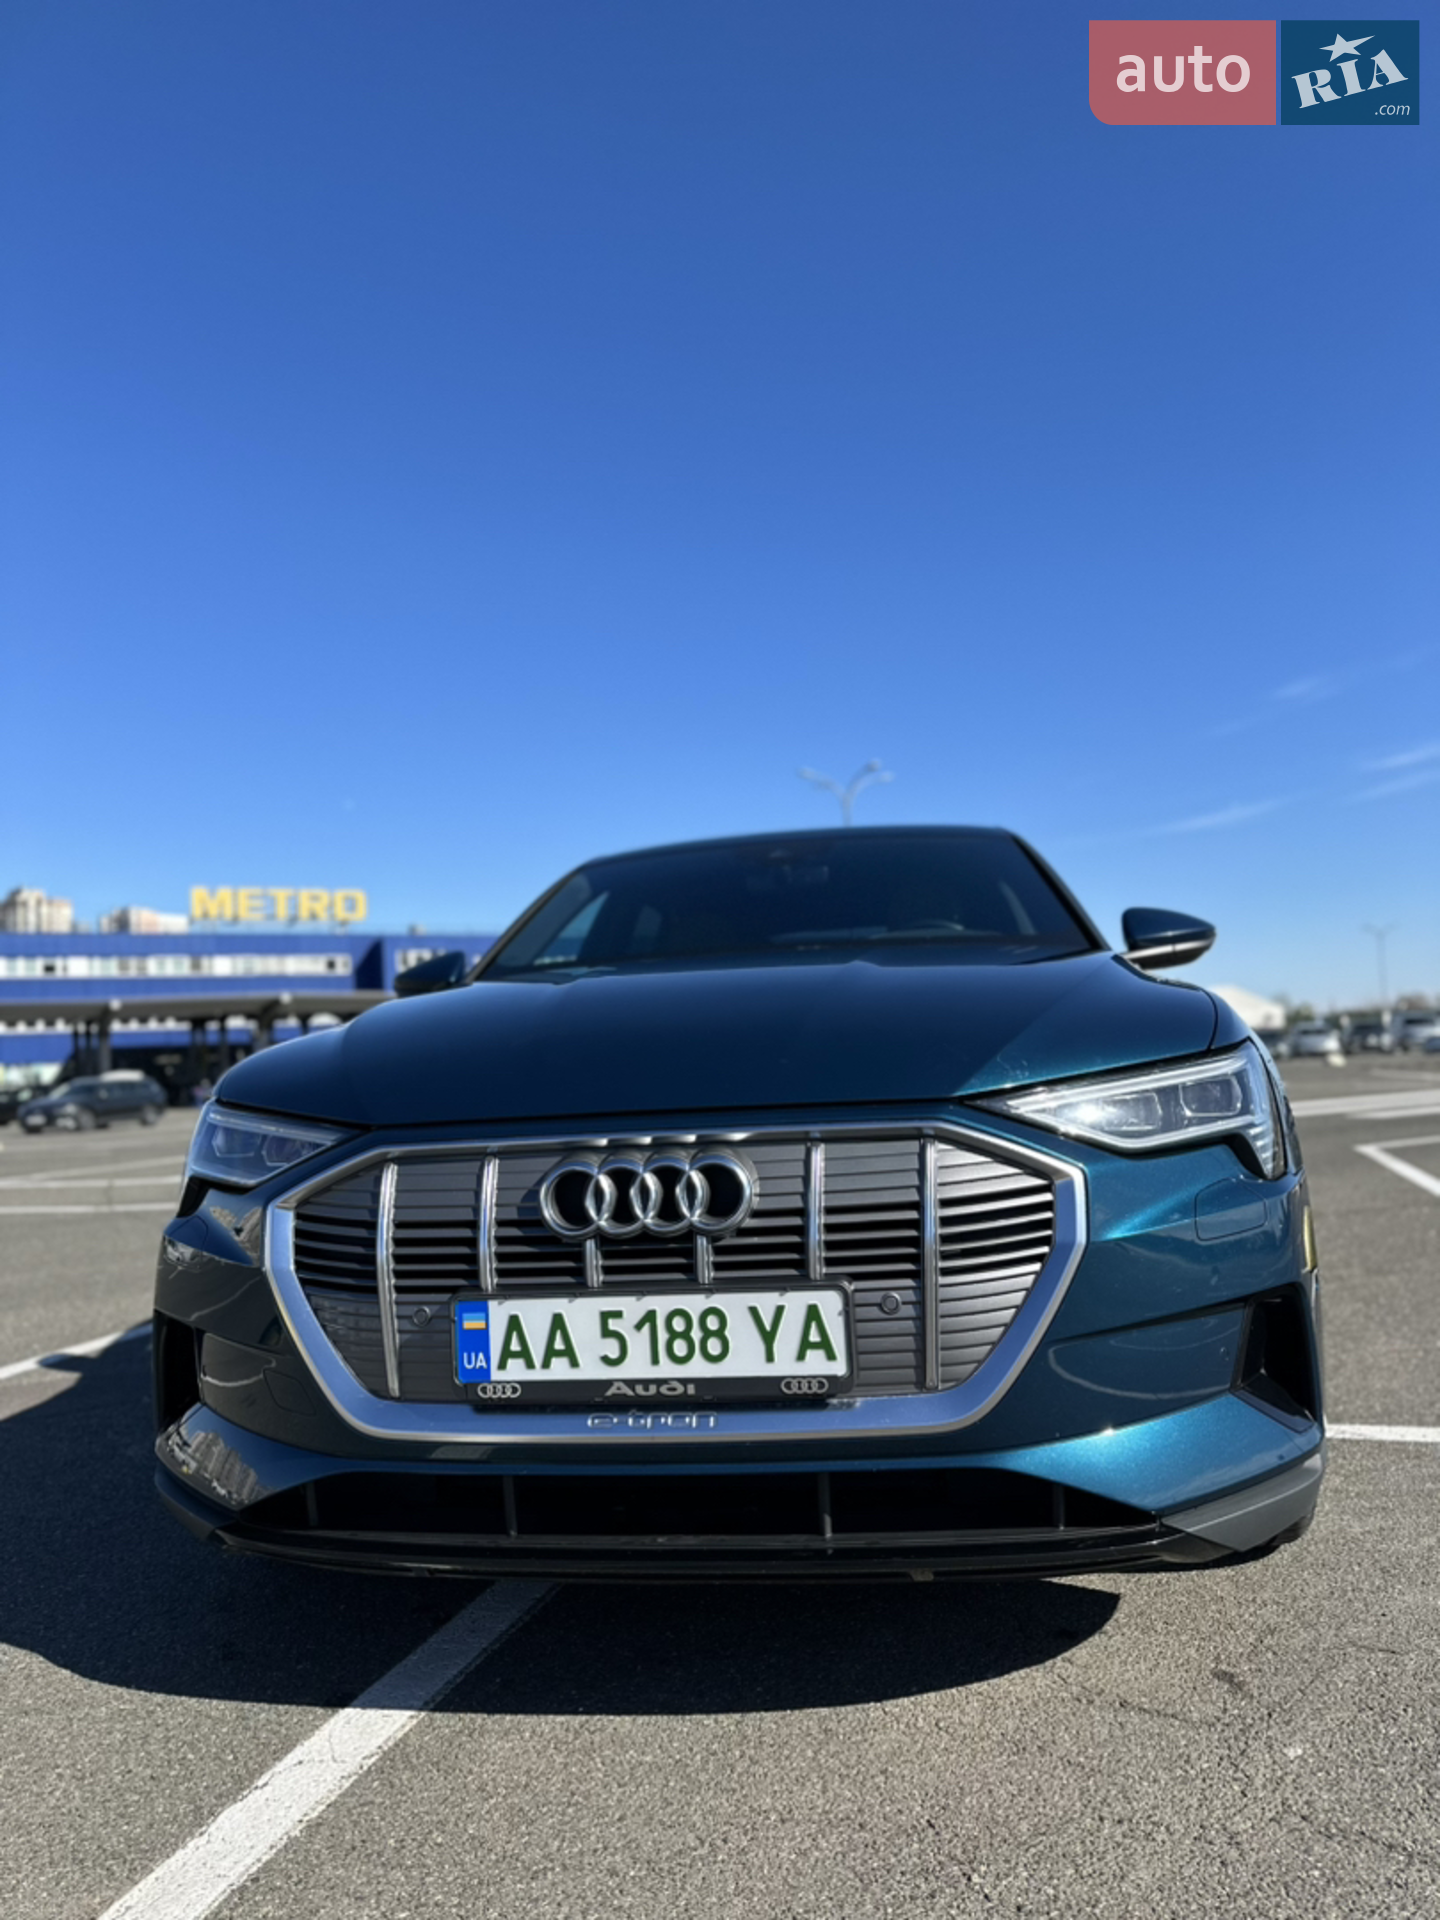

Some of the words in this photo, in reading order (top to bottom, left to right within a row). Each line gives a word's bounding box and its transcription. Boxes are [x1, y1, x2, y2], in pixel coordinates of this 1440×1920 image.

[190, 886, 368, 922] METRO
[497, 1312, 581, 1371] AA
[599, 1306, 731, 1367] 5188
[748, 1303, 838, 1363] YA
[463, 1353, 488, 1369] UA
[604, 1380, 697, 1397] Audi
